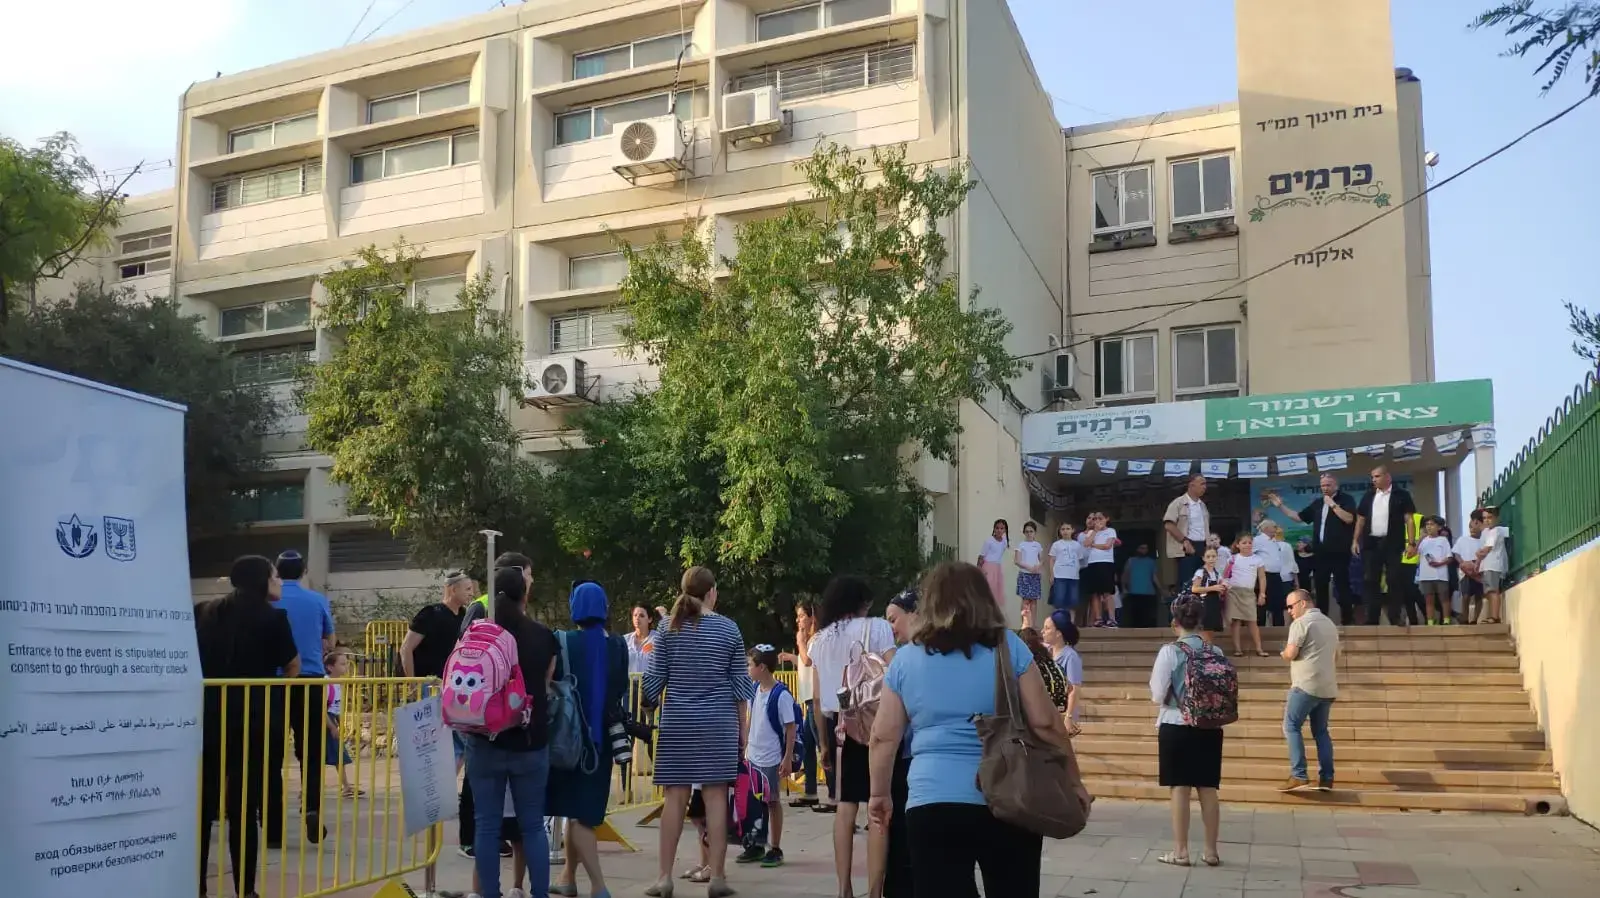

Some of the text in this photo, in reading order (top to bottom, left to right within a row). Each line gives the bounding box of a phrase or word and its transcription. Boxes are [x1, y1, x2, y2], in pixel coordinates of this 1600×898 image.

[1305, 109, 1347, 129] חינוך
[1353, 104, 1383, 118] בית
[1293, 247, 1354, 268] אלקנה
[1248, 394, 1355, 412] ישמור
[1056, 414, 1152, 436] כרמים
[1216, 406, 1439, 435] צאתך ובואך!
[30, 601, 52, 613] בידוק
[54, 603, 78, 615] לעבור
[80, 604, 117, 617] בהסכמה
[8, 643, 189, 661] Entrance to the event is stipulated upon
[10, 662, 189, 676] consent to go through a security check
[60, 719, 96, 737] الخضوع
[99, 718, 116, 733] على
[34, 832, 178, 862] вход обязывает прохождение
[50, 849, 165, 878] проверки безопасности
